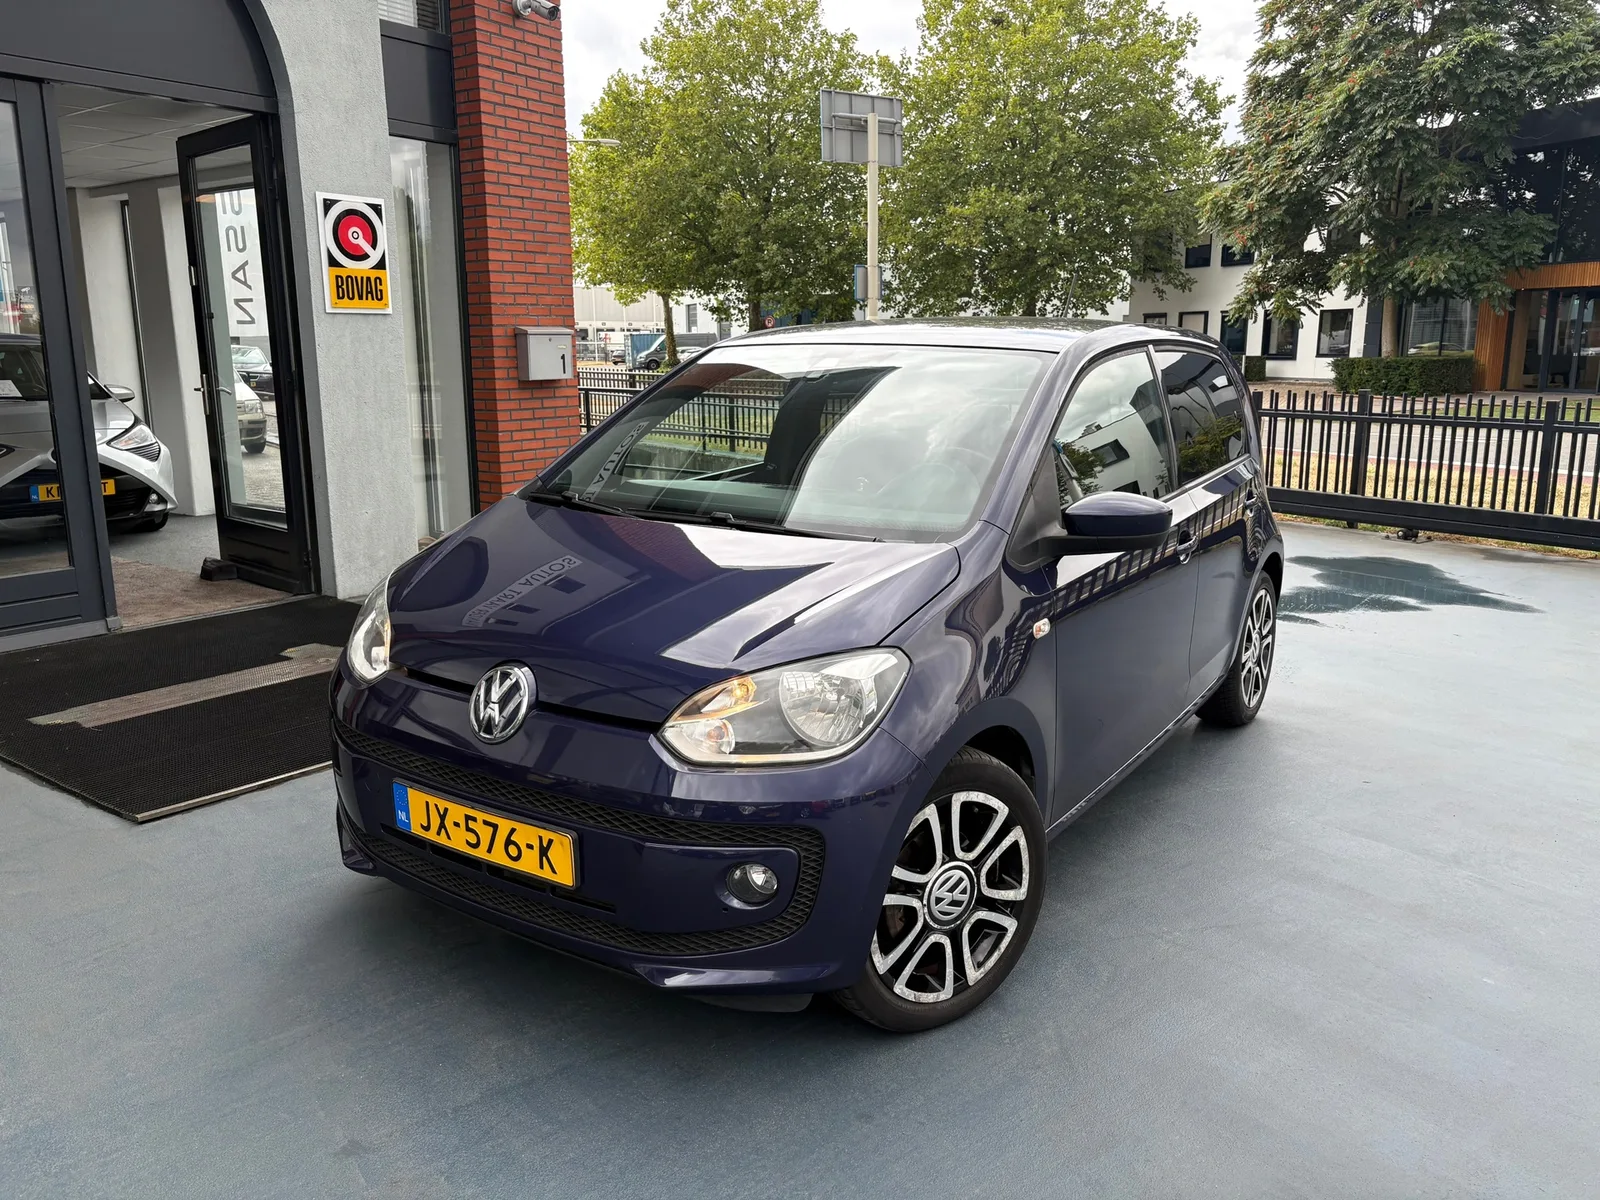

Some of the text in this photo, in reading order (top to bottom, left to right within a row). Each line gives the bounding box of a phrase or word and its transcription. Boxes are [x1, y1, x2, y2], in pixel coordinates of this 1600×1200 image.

[335, 274, 384, 302] BOVAG
[560, 353, 566, 375] 1
[398, 809, 409, 823] NL
[420, 800, 558, 875] JX-576-K
